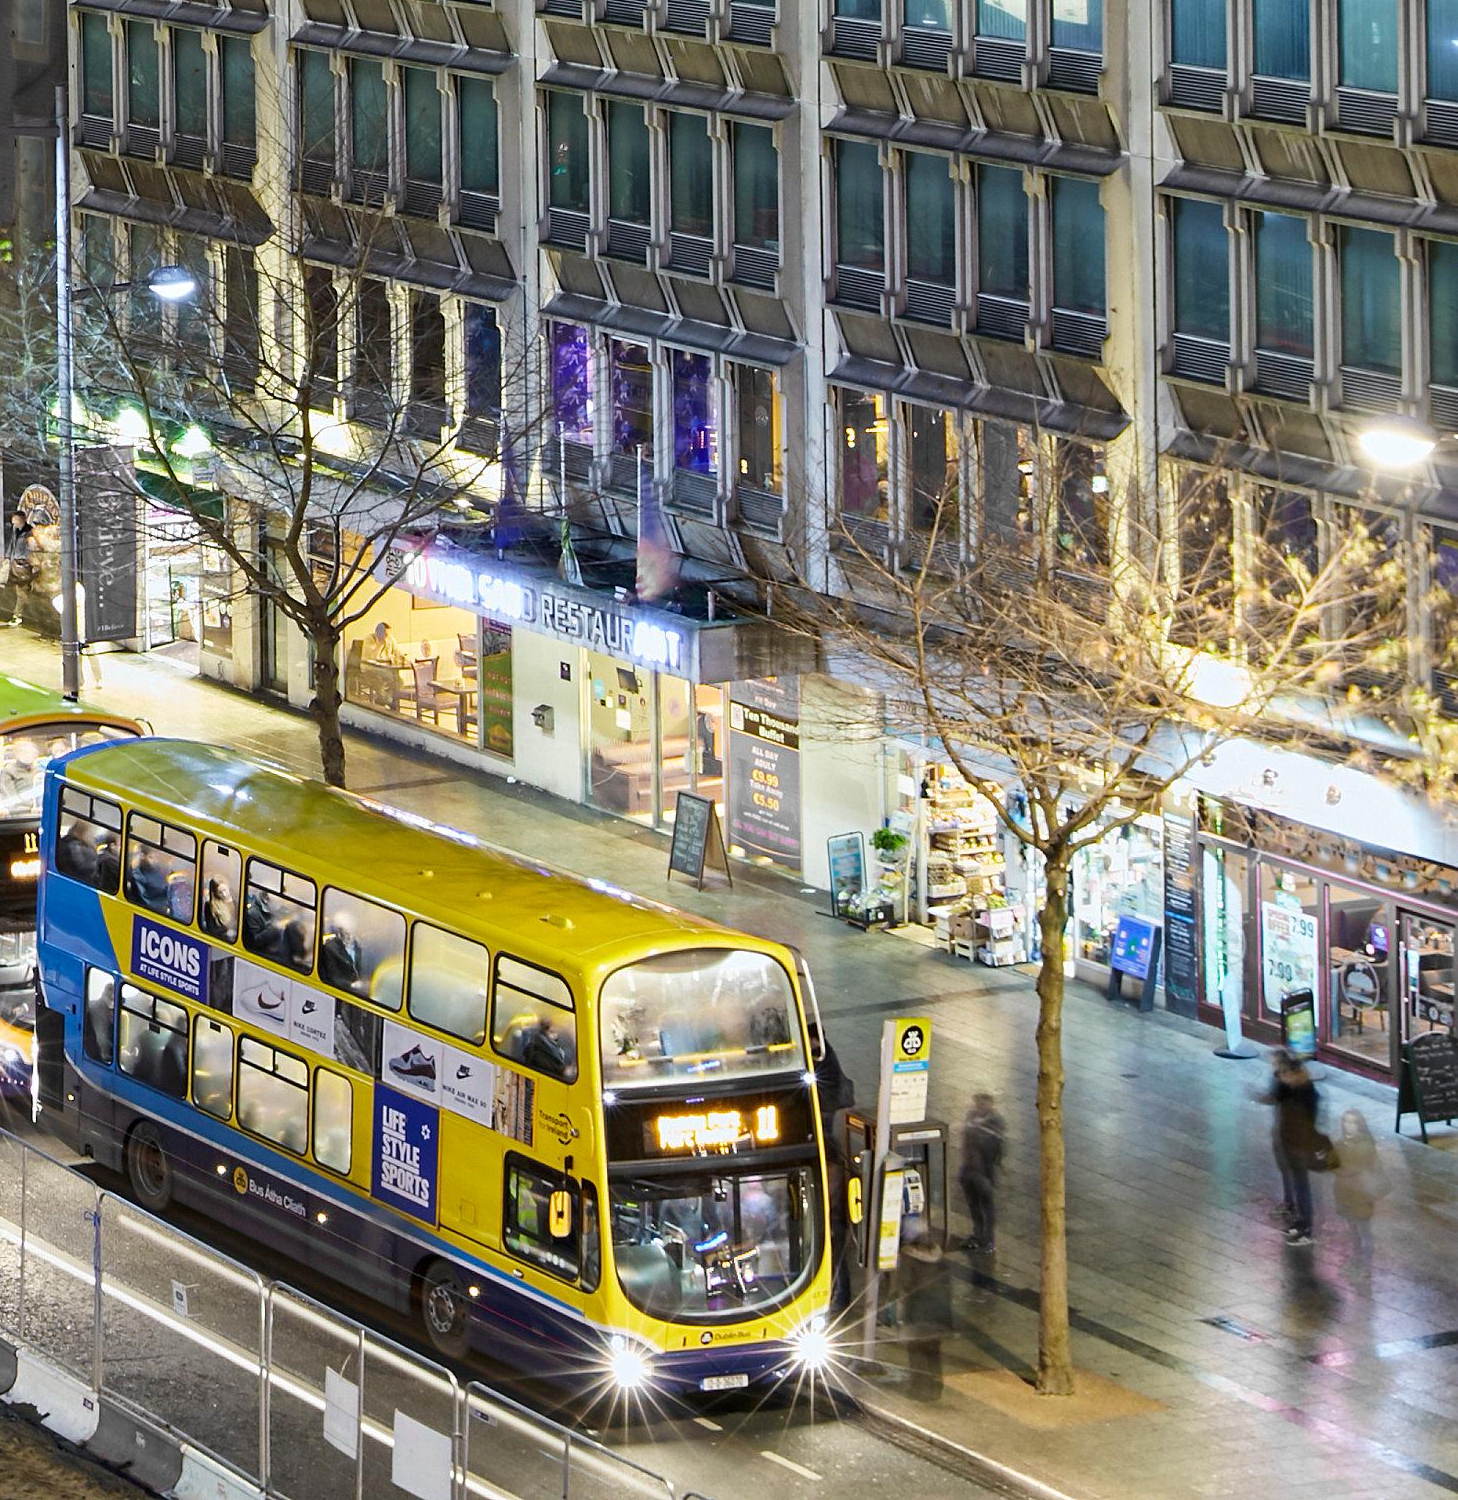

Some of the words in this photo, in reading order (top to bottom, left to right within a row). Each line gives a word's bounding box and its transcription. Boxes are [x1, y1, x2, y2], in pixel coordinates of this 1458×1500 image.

[541, 593, 680, 668] RESTAURANT
[1290, 916, 1314, 938] 7.99
[140, 926, 200, 977] ICONS
[139, 962, 147, 974] AT
[147, 966, 159, 980] LIFE
[160, 971, 177, 987] STYLE
[178, 978, 200, 996] SPORTS
[1269, 958, 1293, 982] 7.99
[293, 1020, 305, 1031] NIKE
[442, 1084, 455, 1095] NIKE
[457, 1090, 466, 1099] AIR
[467, 1094, 478, 1104] MAX
[382, 1105, 406, 1135] LIFE
[539, 1109, 569, 1129] Transport
[382, 1133, 420, 1169] STYLE
[249, 1179, 264, 1197] Bus
[381, 1161, 430, 1201] SPORTS
